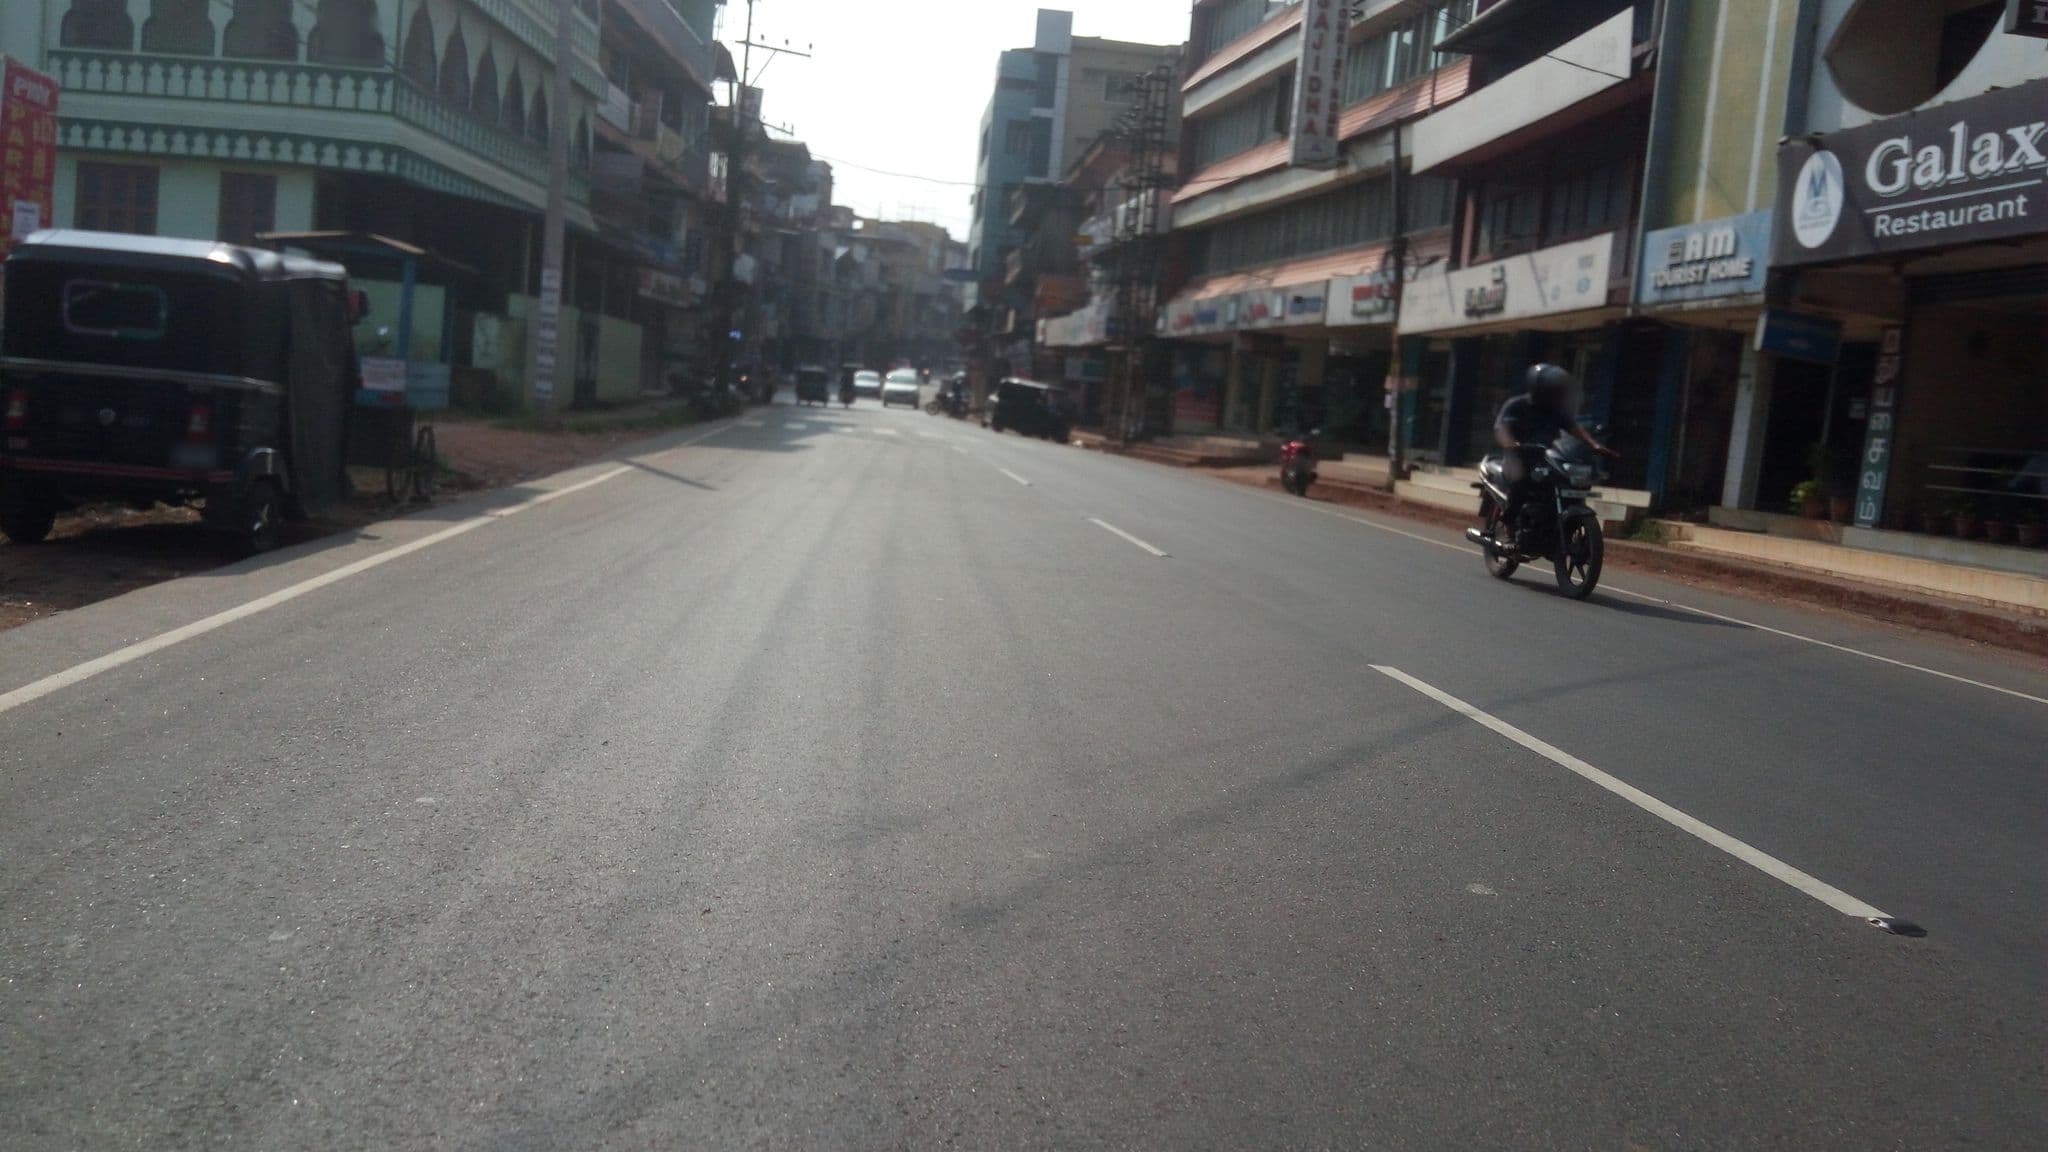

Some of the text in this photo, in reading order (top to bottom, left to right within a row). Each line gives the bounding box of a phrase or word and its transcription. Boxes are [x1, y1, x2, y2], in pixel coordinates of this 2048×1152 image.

[1866, 120, 2048, 195] Galax
[1874, 194, 2028, 238] Restaurant
[1648, 256, 1752, 288] TOURIST HOME
